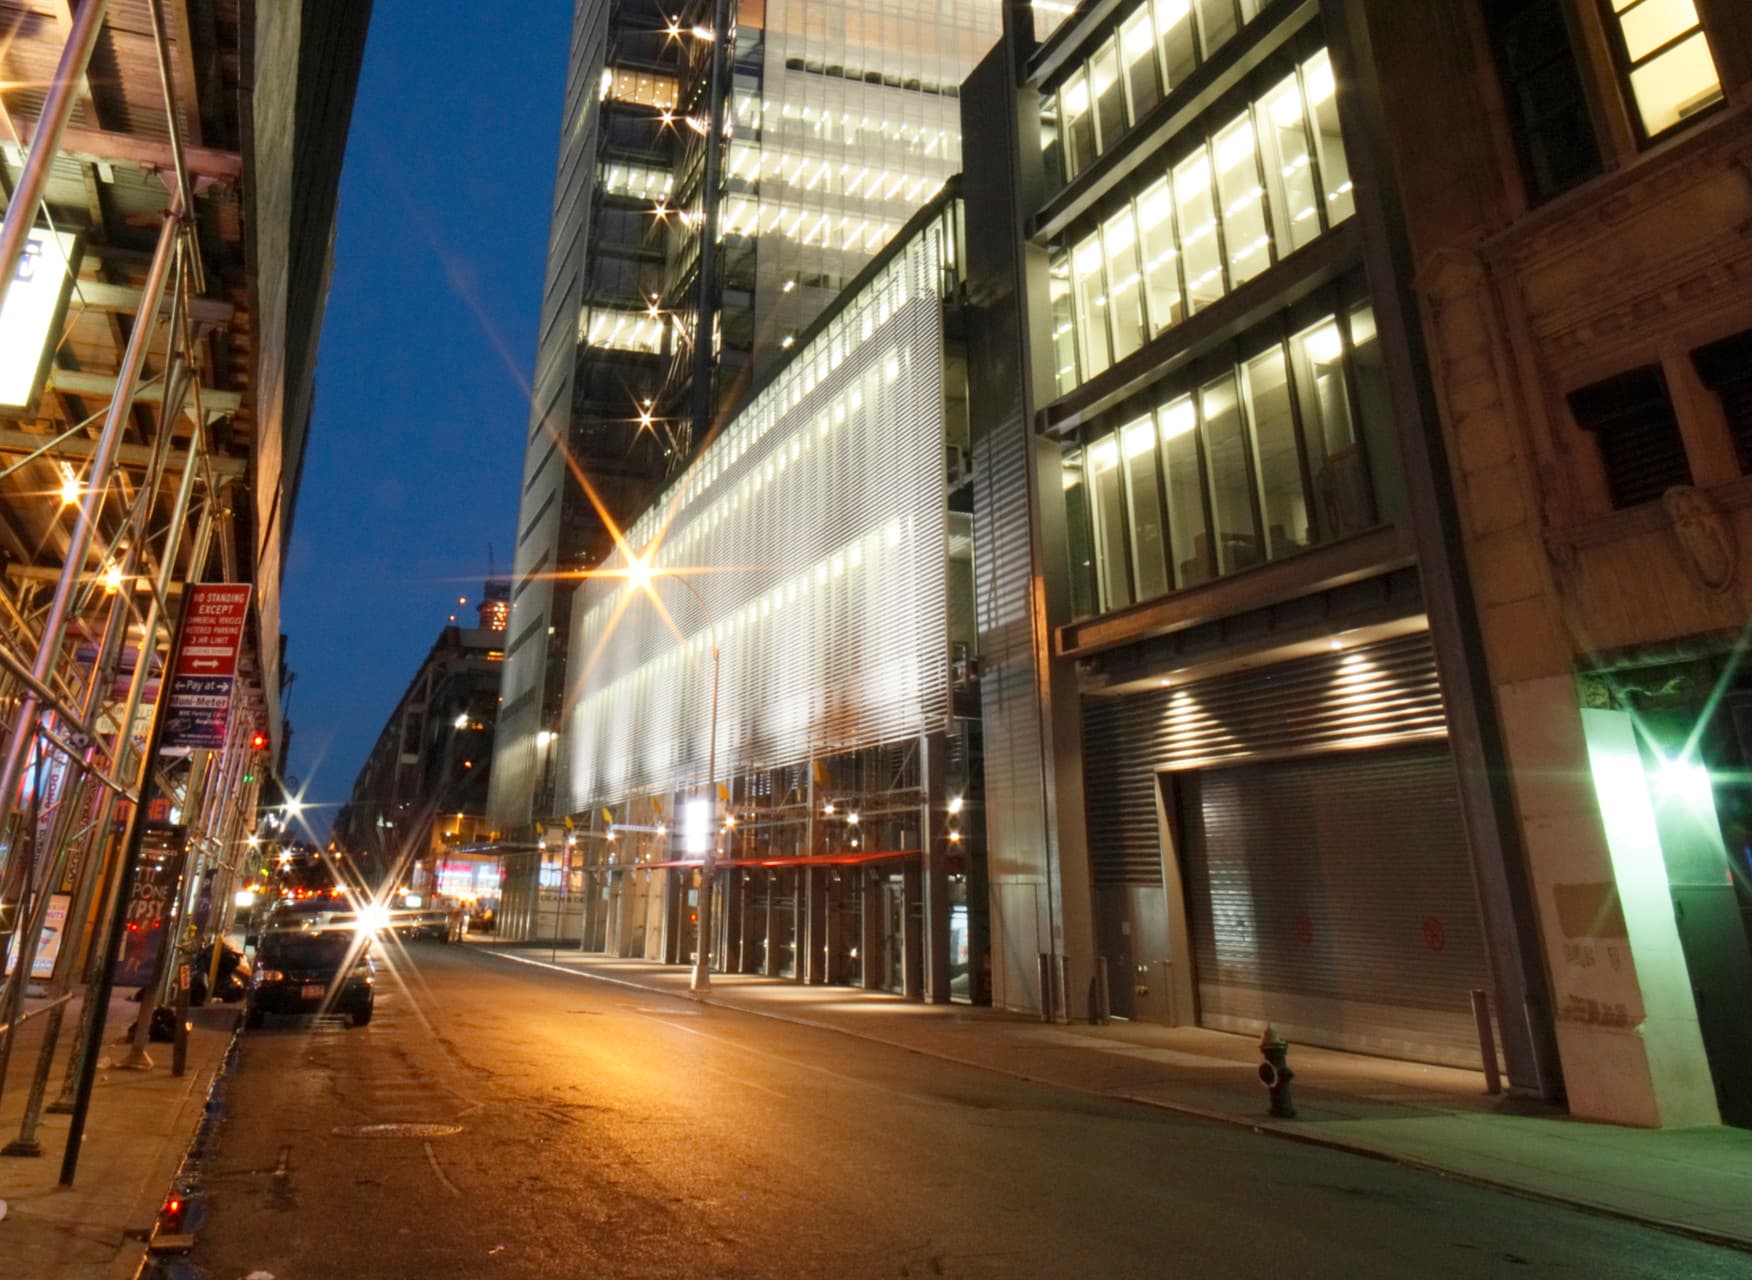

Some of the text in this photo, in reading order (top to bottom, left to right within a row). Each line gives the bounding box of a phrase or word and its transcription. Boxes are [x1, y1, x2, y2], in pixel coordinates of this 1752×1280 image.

[193, 593, 245, 603] NO STANDING
[198, 605, 234, 614] EXCEPT
[187, 680, 215, 692] Pay at
[131, 883, 170, 900] PONE
